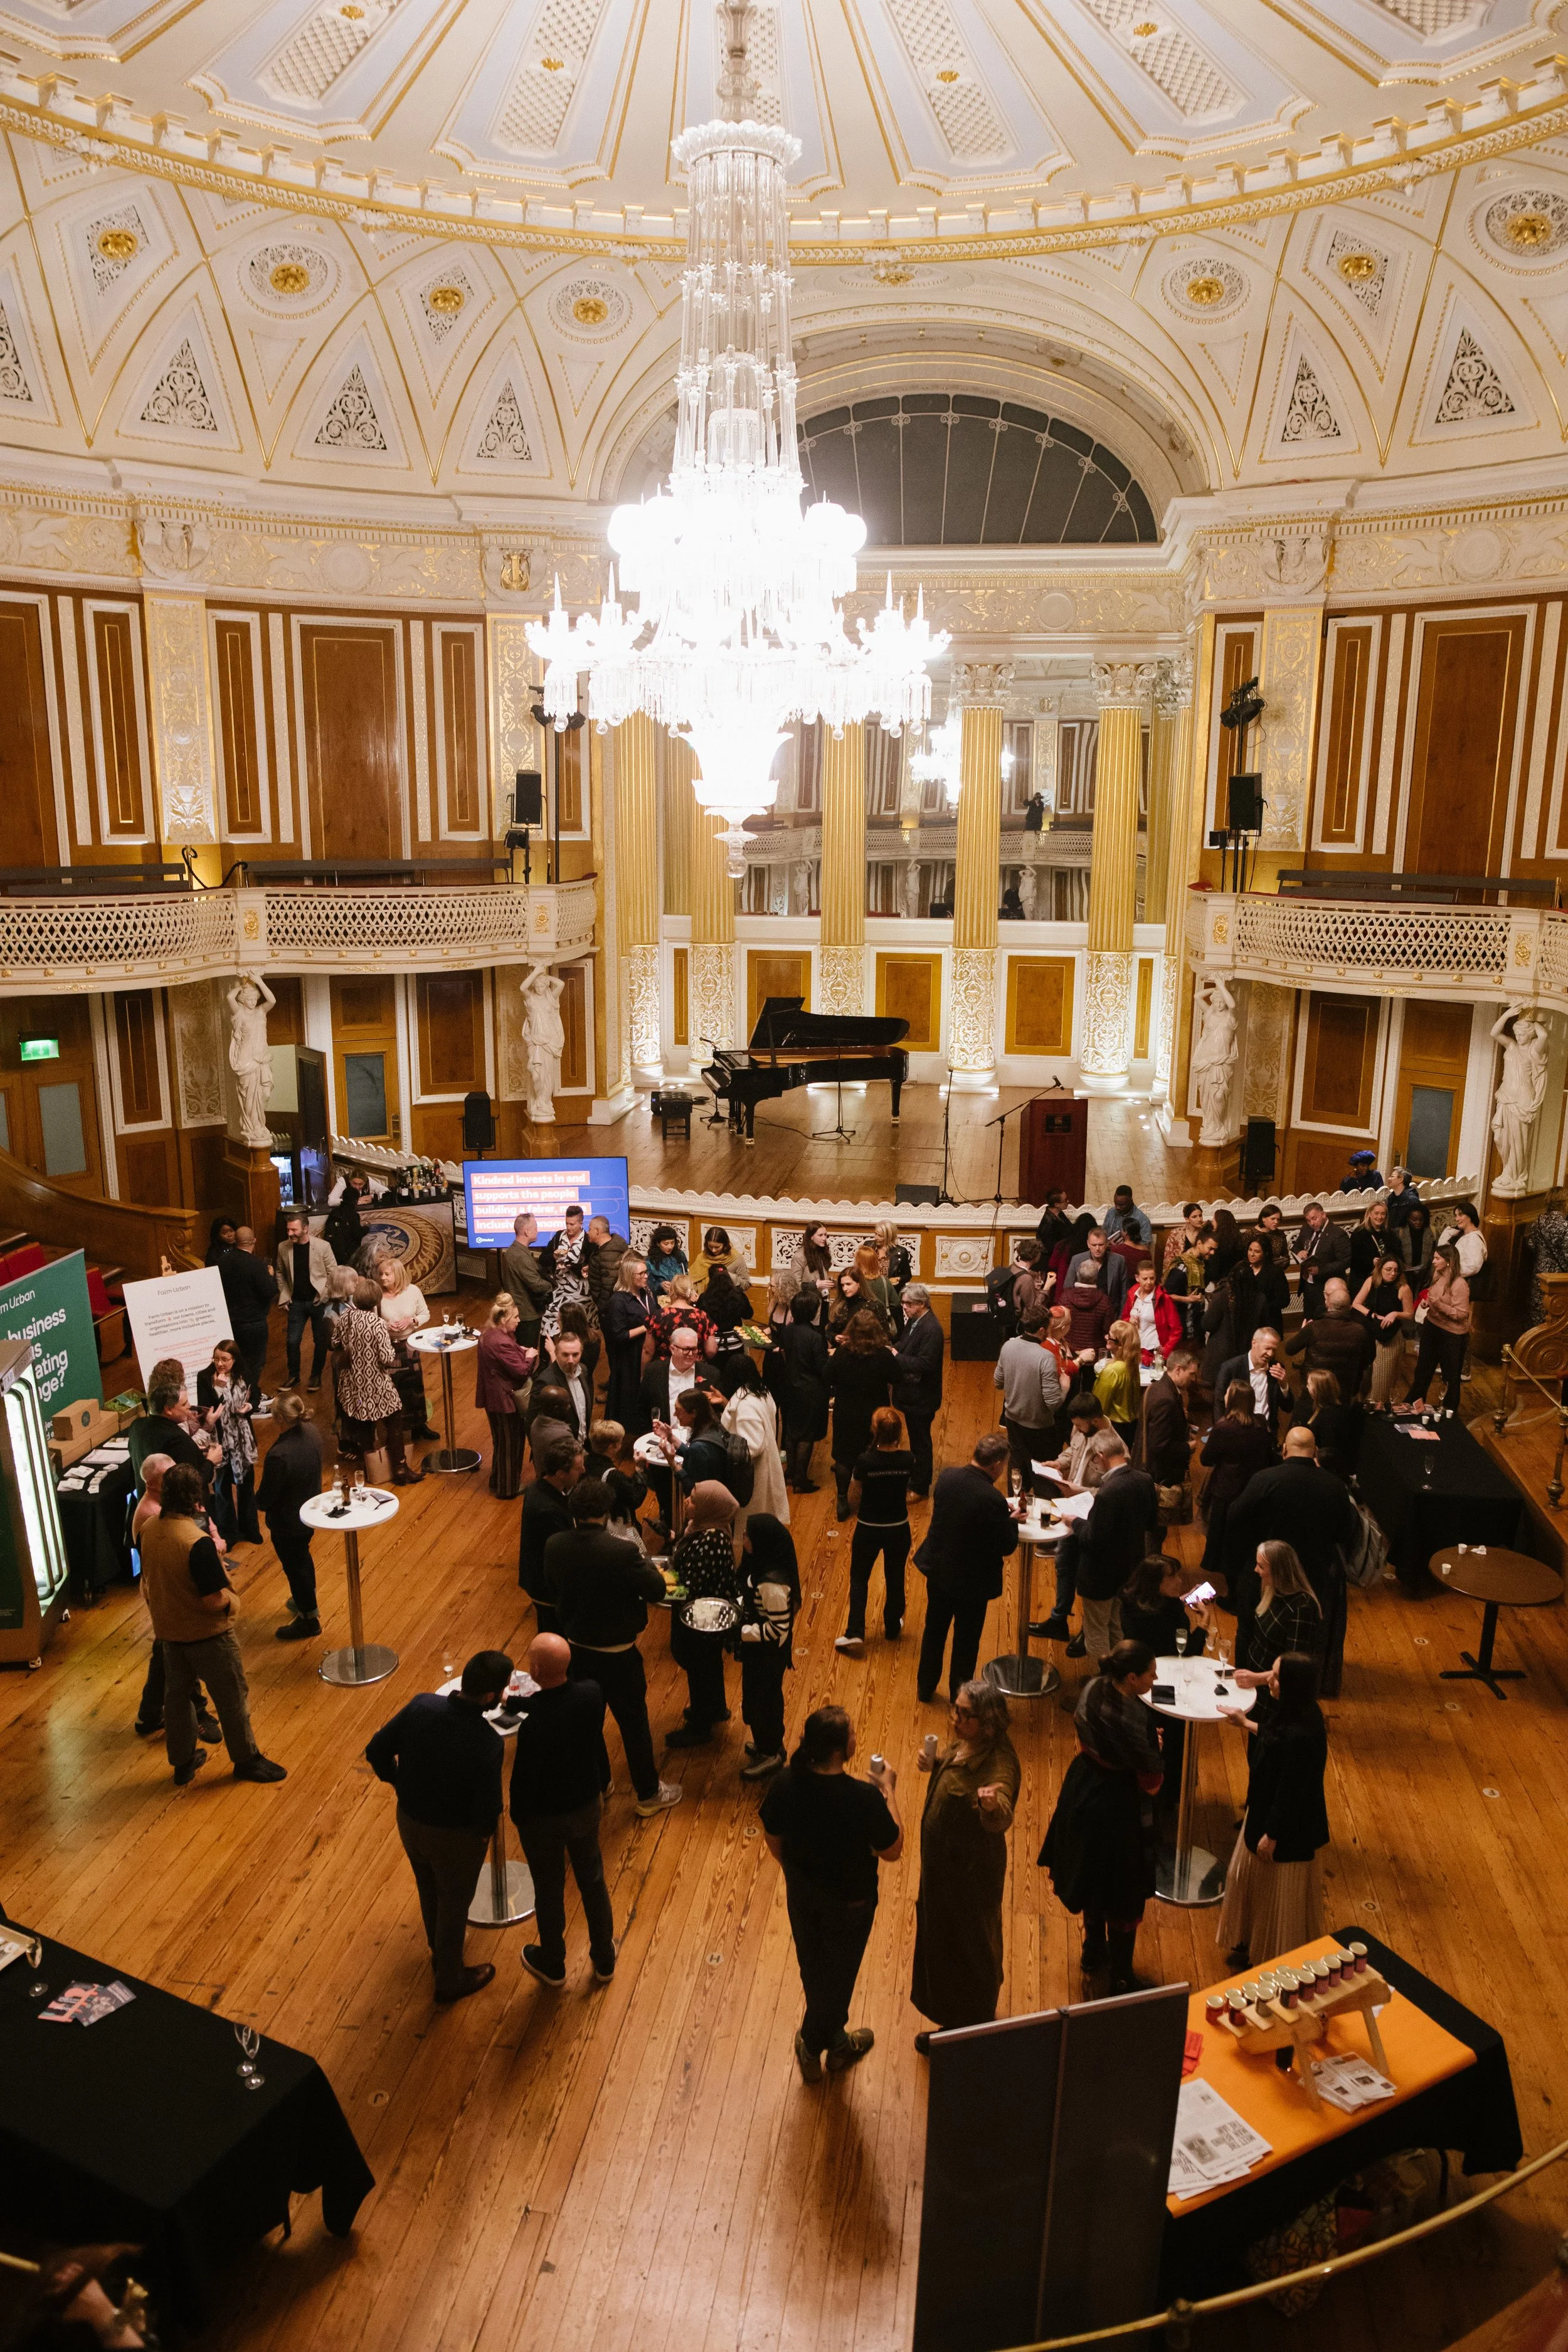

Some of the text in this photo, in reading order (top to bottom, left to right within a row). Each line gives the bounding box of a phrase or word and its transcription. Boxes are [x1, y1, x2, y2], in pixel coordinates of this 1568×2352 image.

[474, 1173, 585, 1185] Kindred invests in and
[475, 1189, 575, 1202] supports the people
[475, 1204, 517, 1216] building
[527, 1204, 558, 1214] fairer,
[476, 1220, 515, 1230] inclusiv
[172, 1285, 191, 1293] Urban
[9, 1290, 35, 1309] Urban
[8, 1308, 66, 1340] business
[144, 1318, 166, 1327] transform
[149, 1322, 179, 1331] organisations
[34, 1350, 68, 1380] ating
[709, 1954, 720, 1963] H
